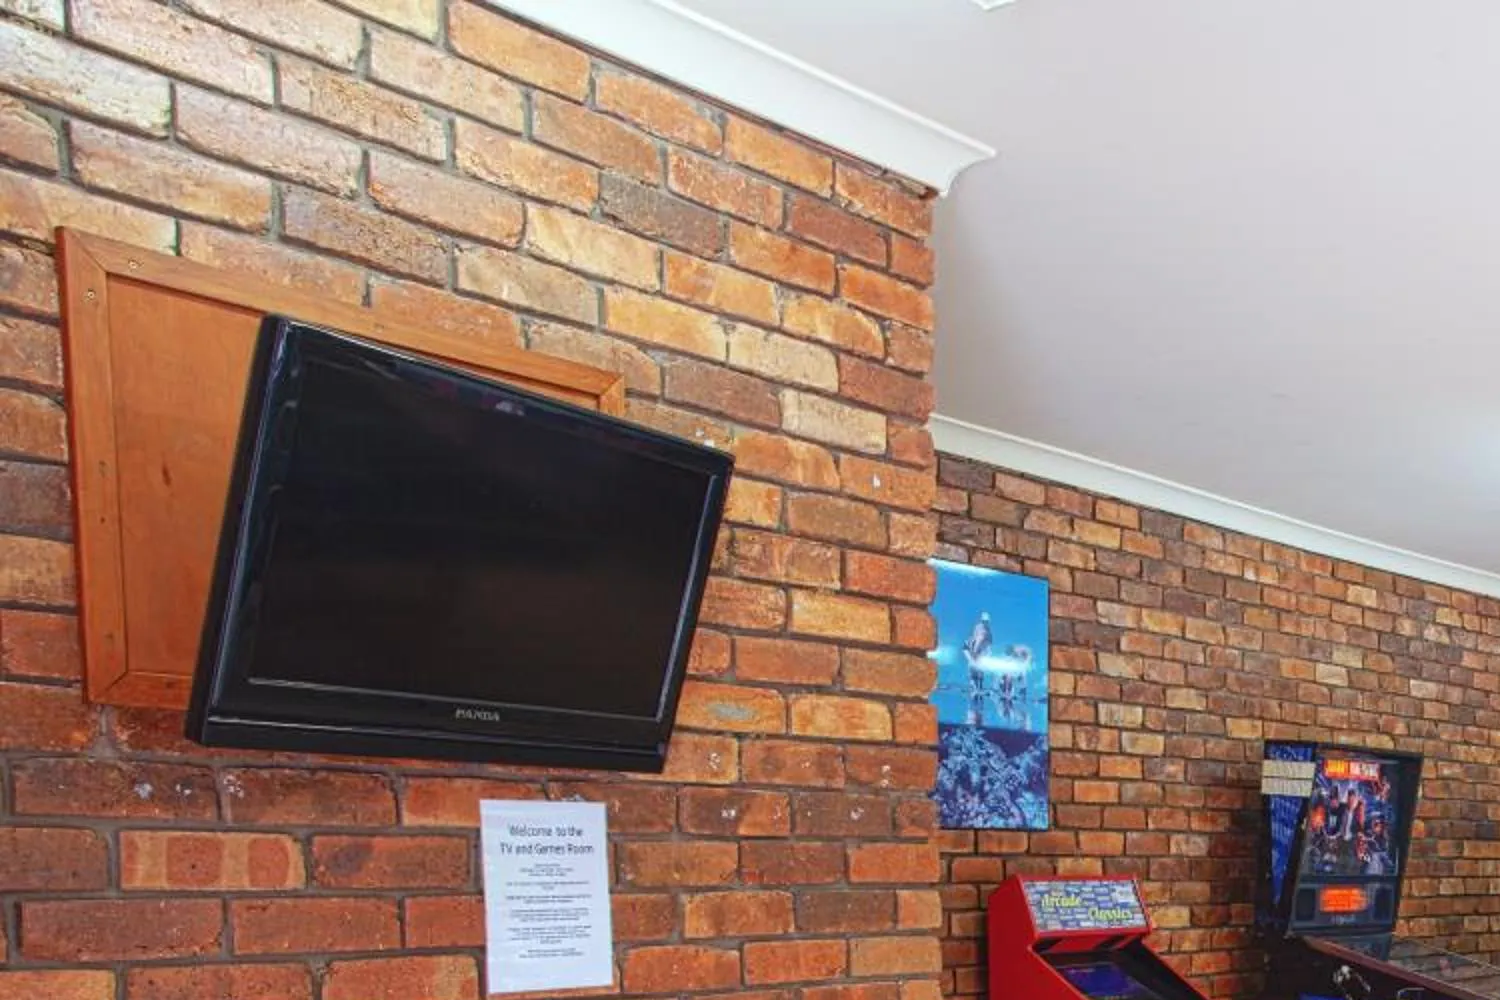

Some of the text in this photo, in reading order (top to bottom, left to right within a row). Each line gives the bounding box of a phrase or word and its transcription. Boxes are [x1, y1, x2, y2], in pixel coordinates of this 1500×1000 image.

[509, 824, 583, 837] Welcome to the
[500, 842, 595, 856] TV and Games Room
